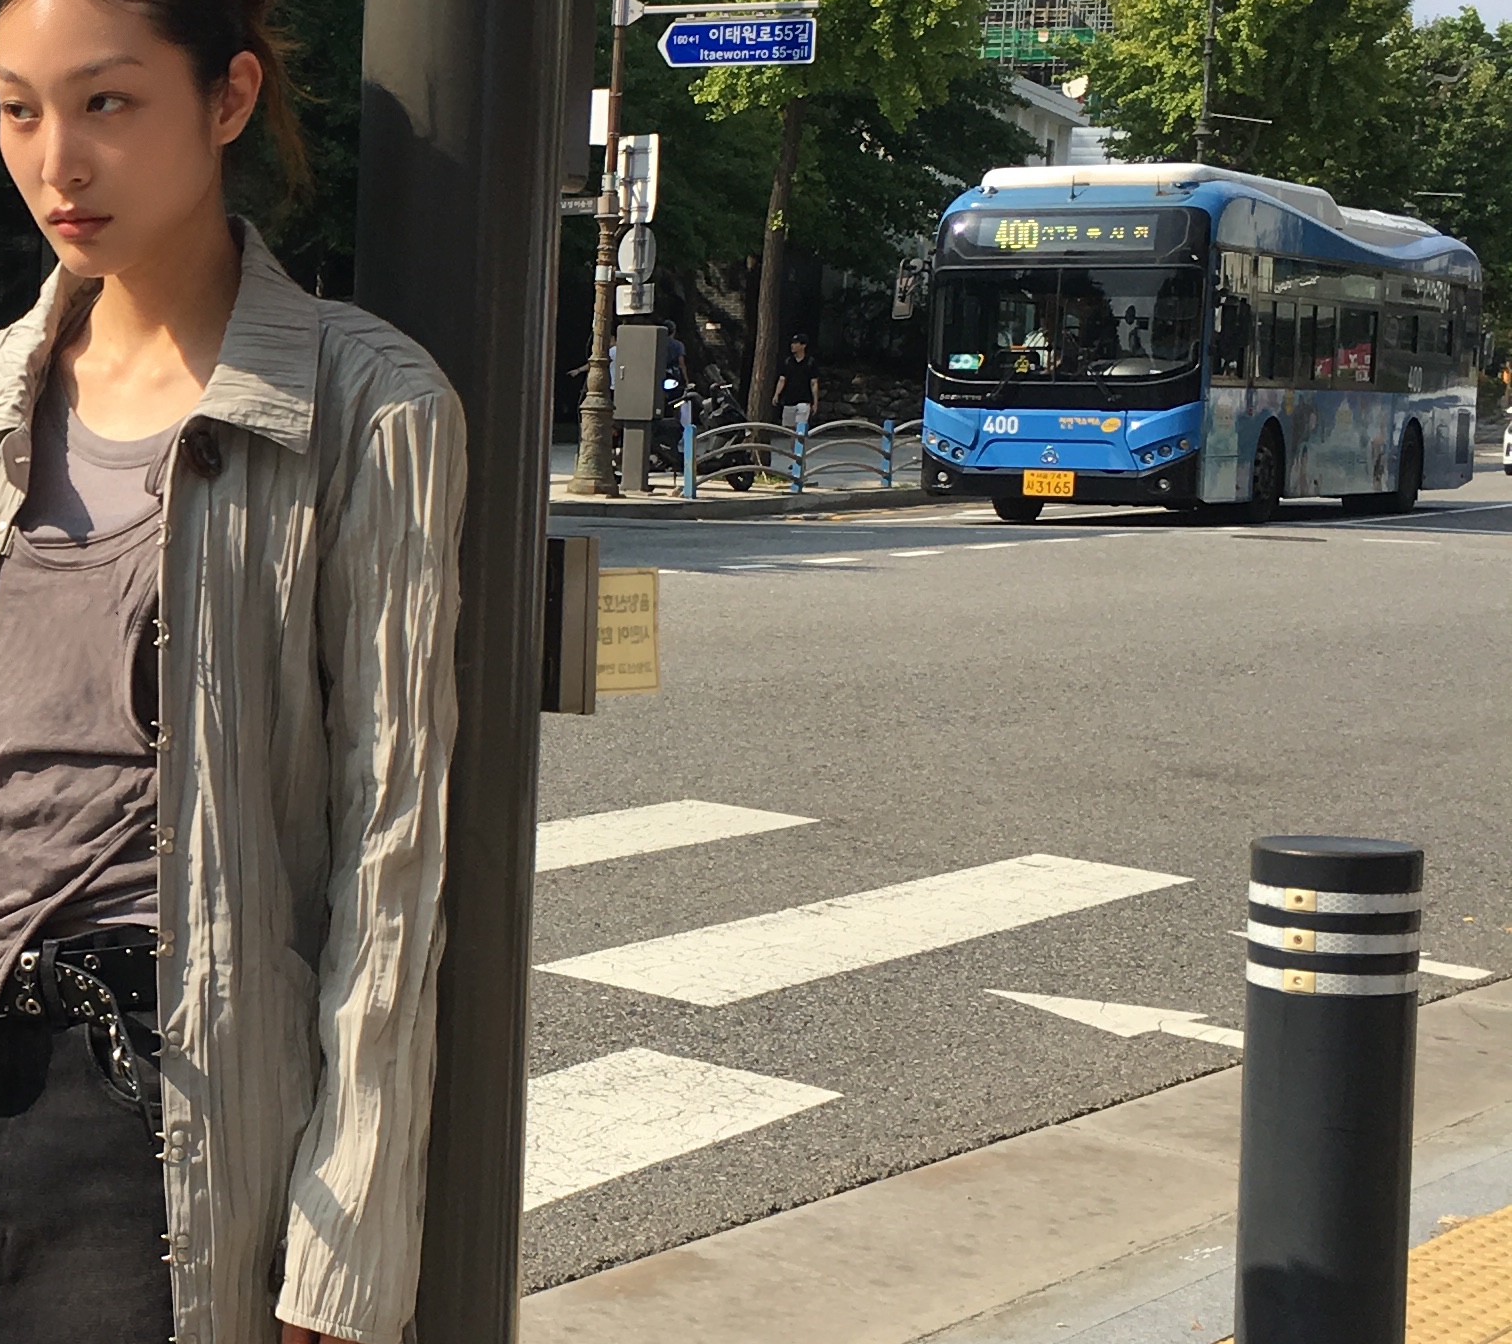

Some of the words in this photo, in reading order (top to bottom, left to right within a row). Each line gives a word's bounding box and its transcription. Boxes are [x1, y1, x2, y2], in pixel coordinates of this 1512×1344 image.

[708, 22, 810, 45] 이태원로55길
[699, 47, 769, 61] Itaewon-ro
[771, 45, 809, 61] 55-gil
[994, 219, 1039, 250] 400
[982, 415, 1019, 435] 400
